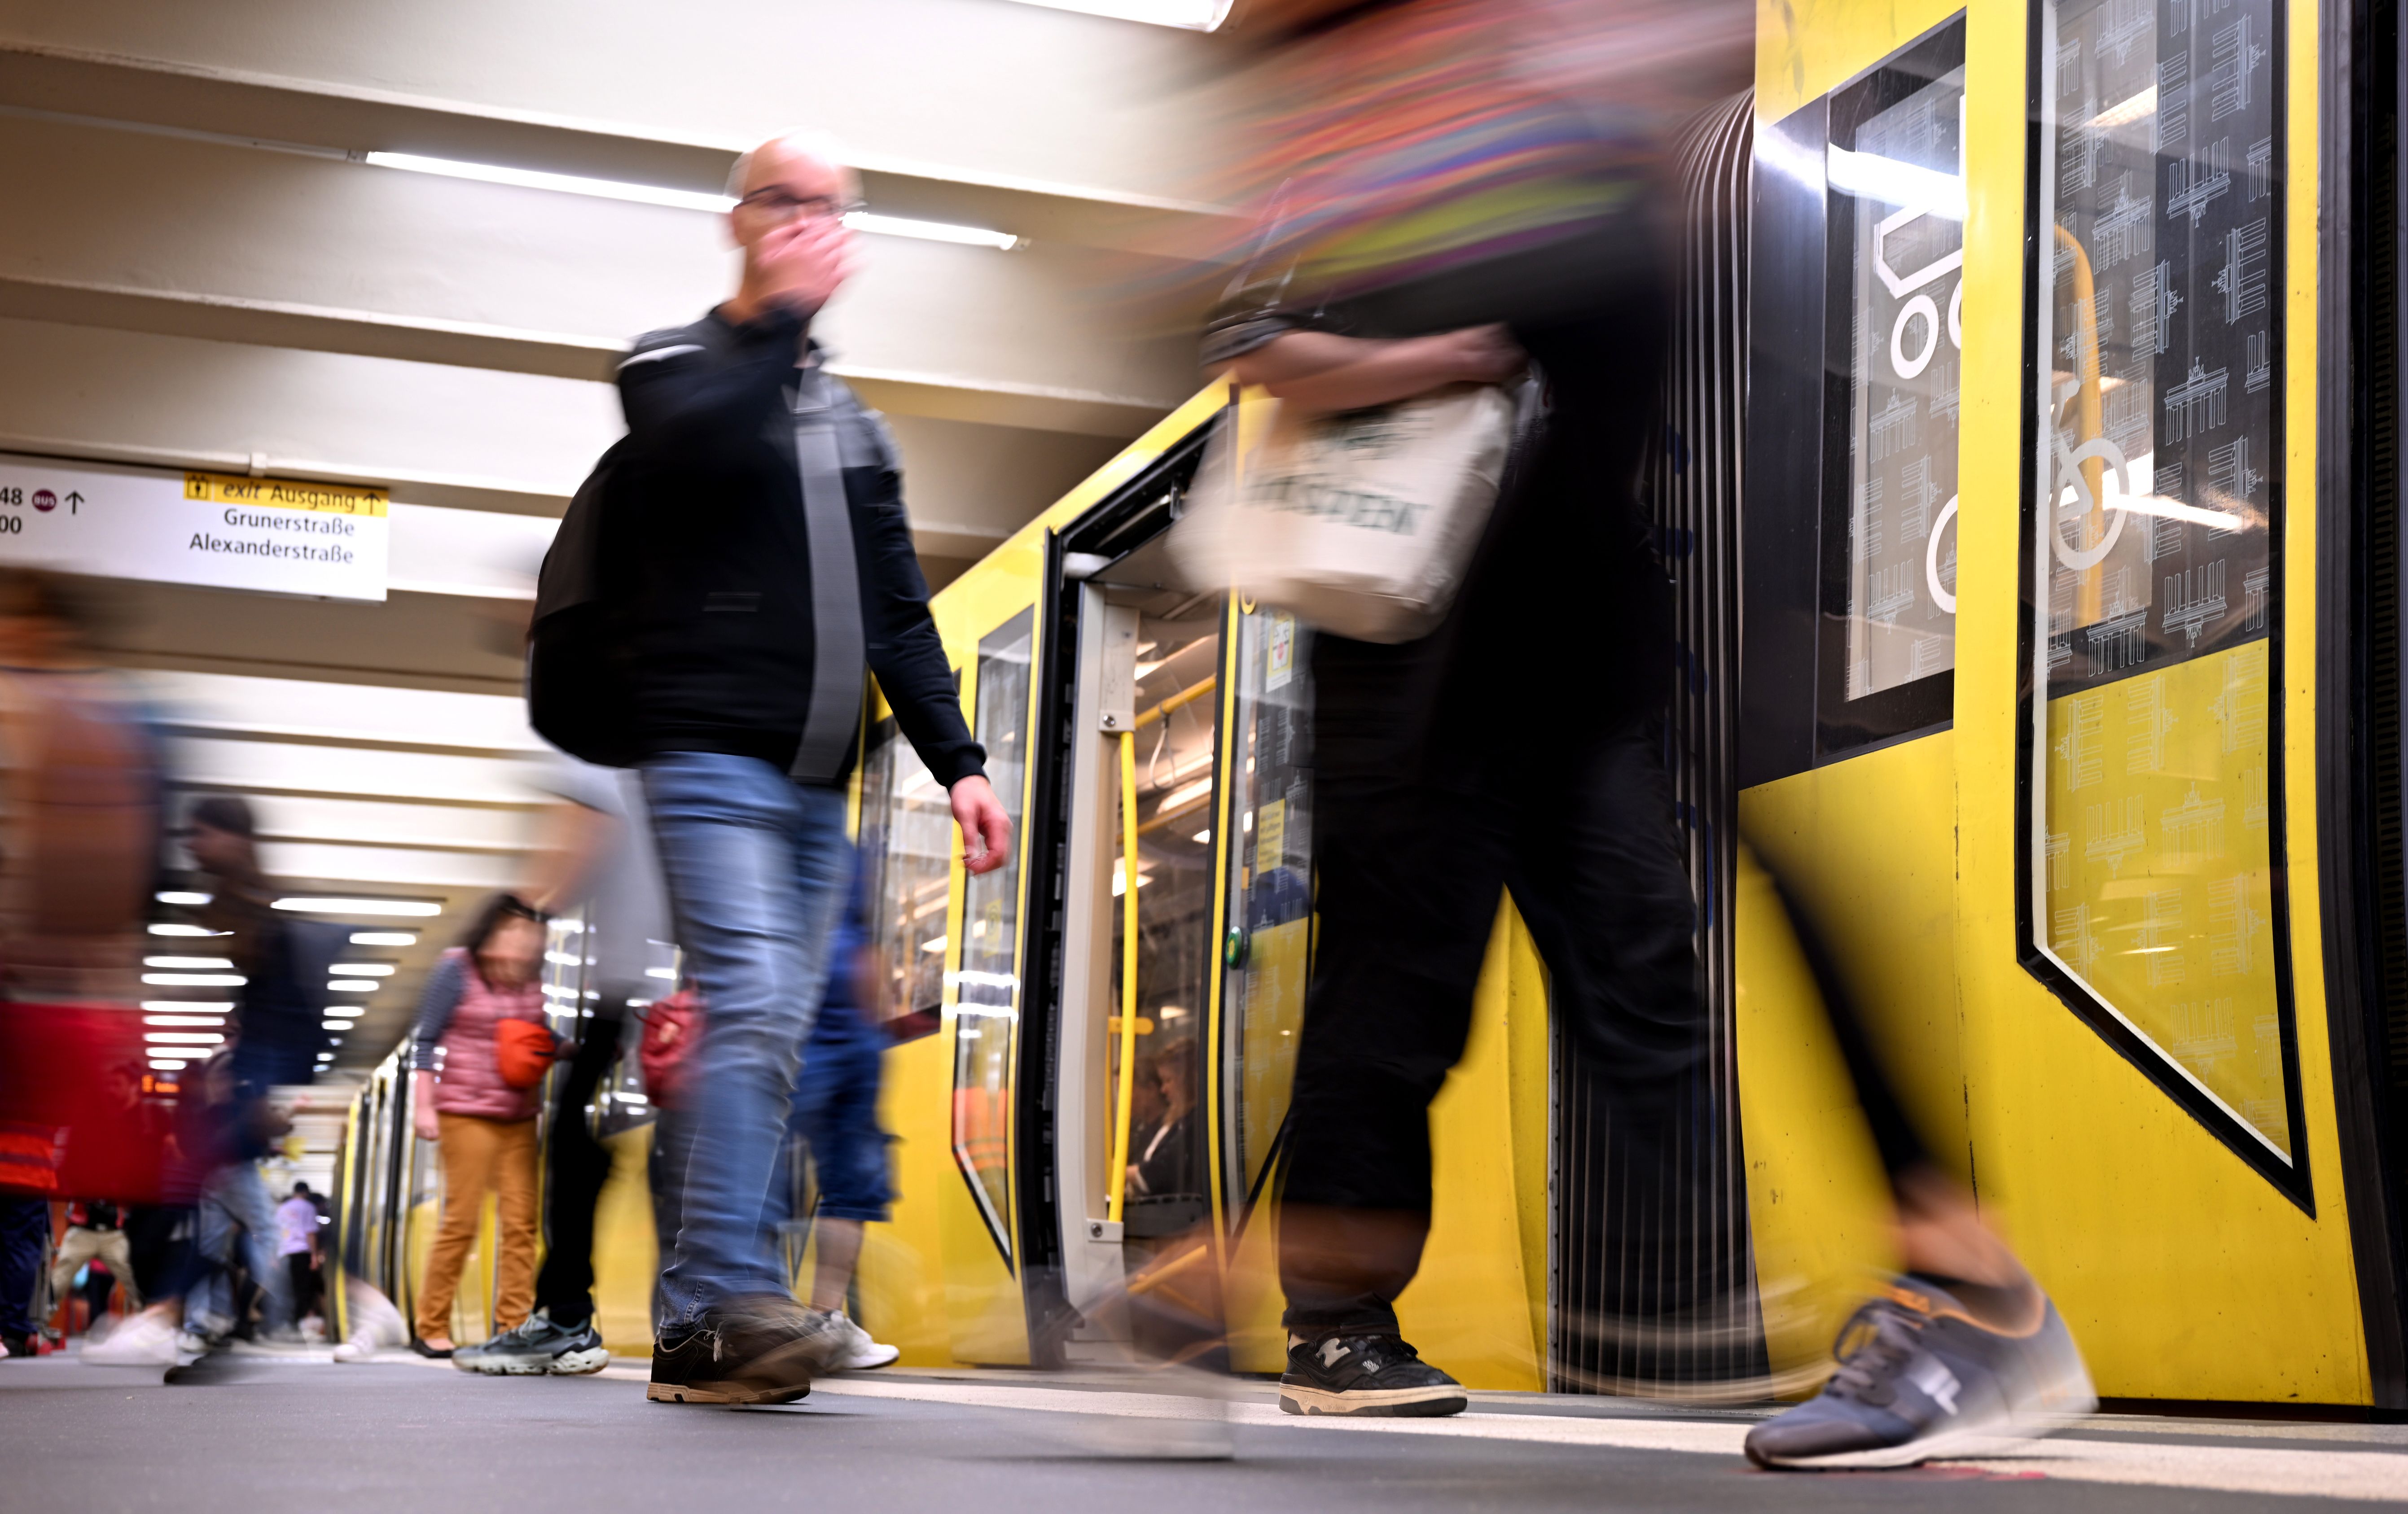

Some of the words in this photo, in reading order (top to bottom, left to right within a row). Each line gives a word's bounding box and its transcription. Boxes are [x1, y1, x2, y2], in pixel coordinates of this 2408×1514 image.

[34, 495, 55, 507] BUS
[223, 481, 262, 499] exit
[270, 484, 356, 513] Ausgang
[224, 508, 355, 536] Grunerstraße
[189, 533, 353, 564] Alexanderstraße
